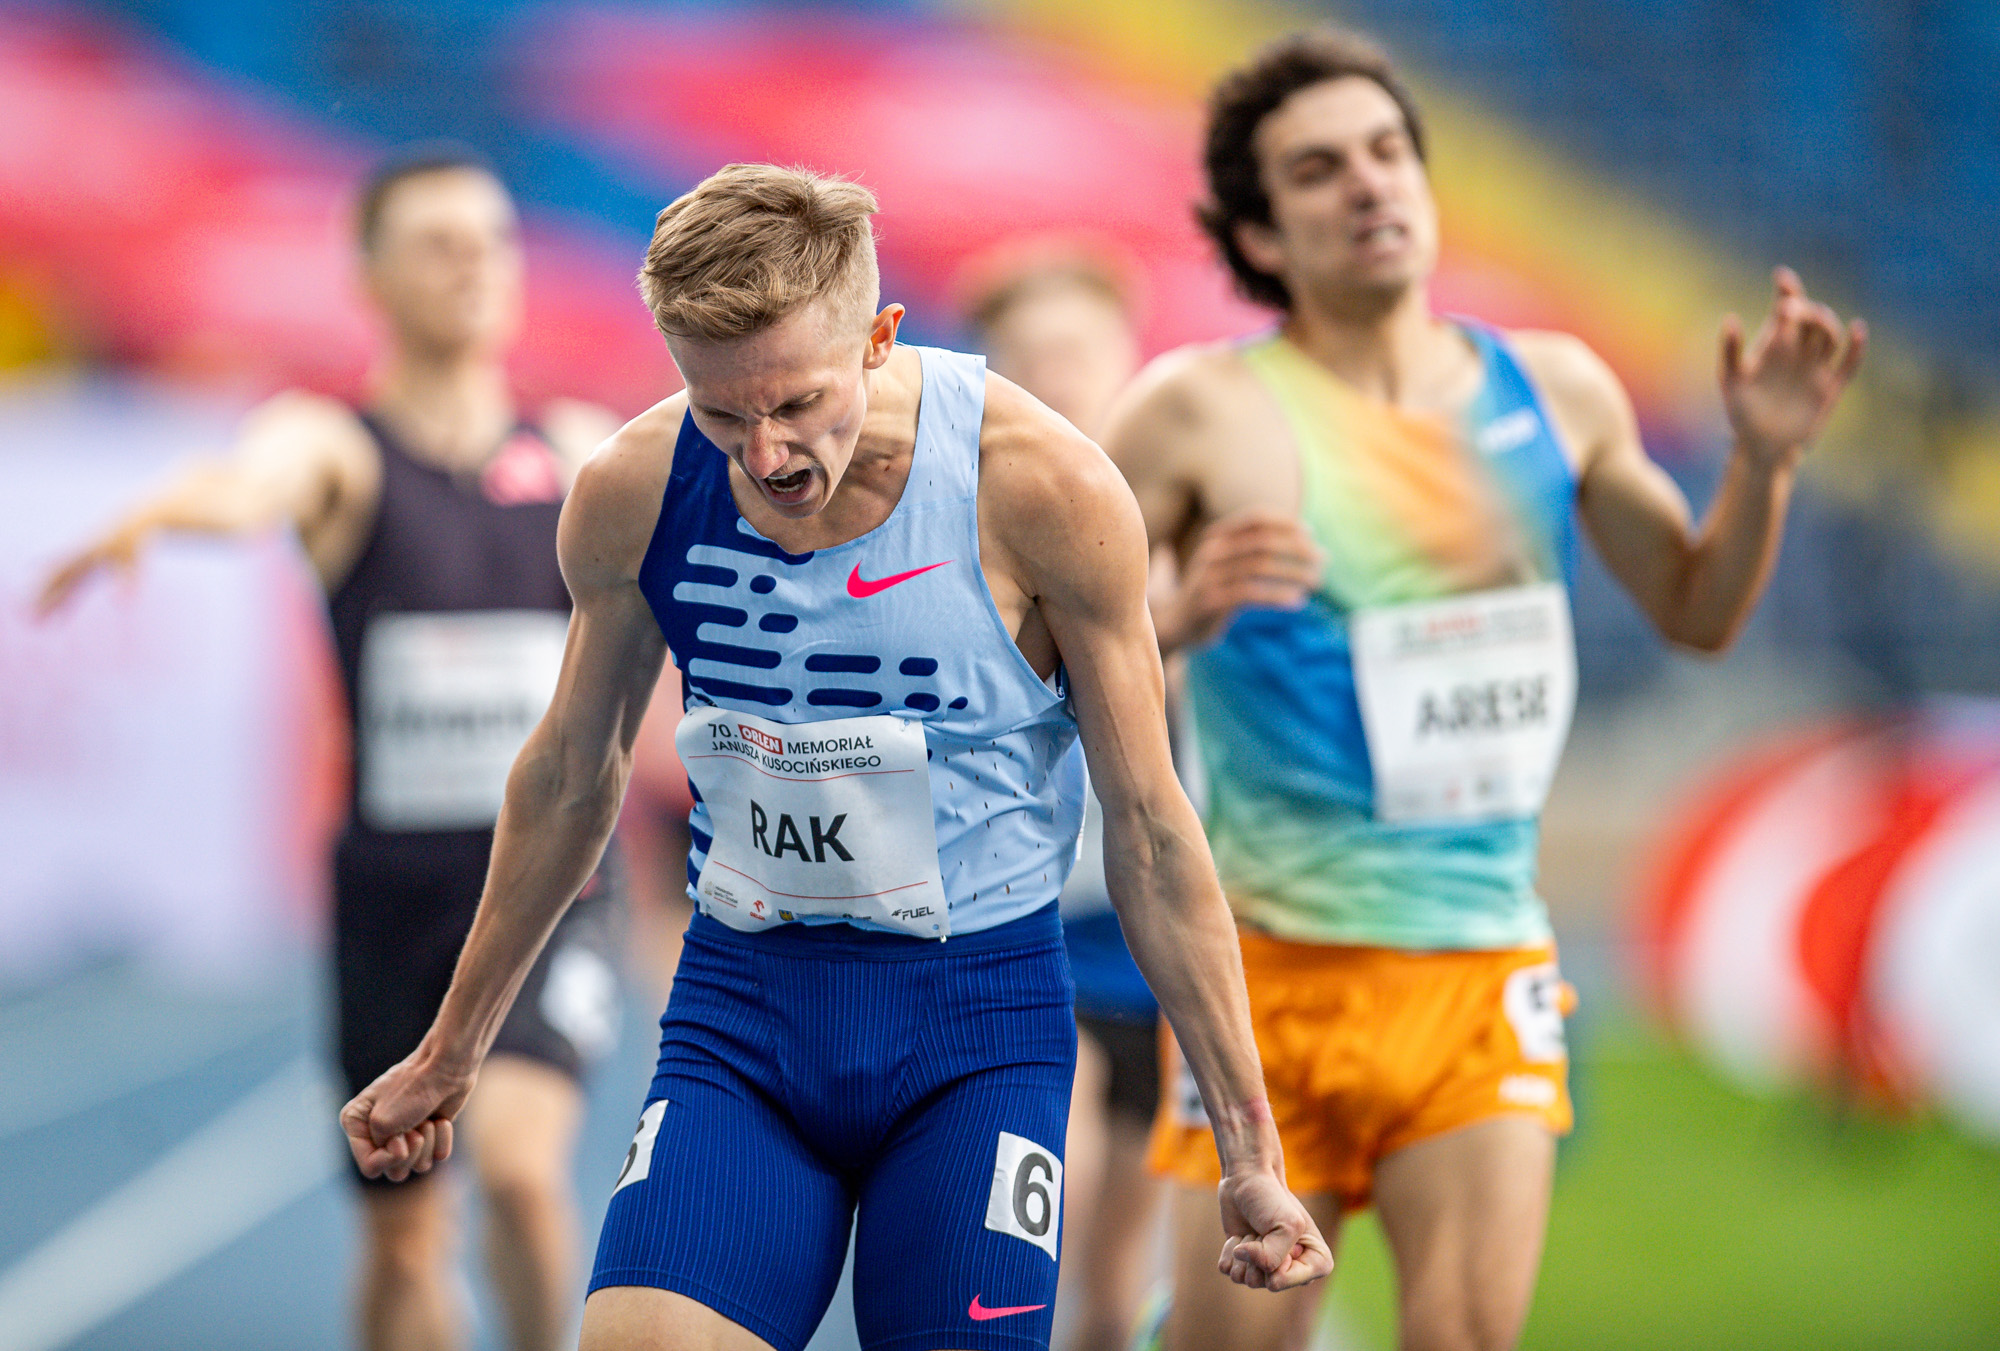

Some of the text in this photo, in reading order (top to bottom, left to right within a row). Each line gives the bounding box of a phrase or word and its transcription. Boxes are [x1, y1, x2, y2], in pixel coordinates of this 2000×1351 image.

[708, 723, 874, 755] 70. ORLEN MEMORIAŁ
[712, 741, 882, 774] JANUSZA KUSOCIŃSKIEGO
[750, 798, 856, 863] RAK
[902, 906, 935, 920] FUEL
[1012, 1152, 1054, 1236] 6
